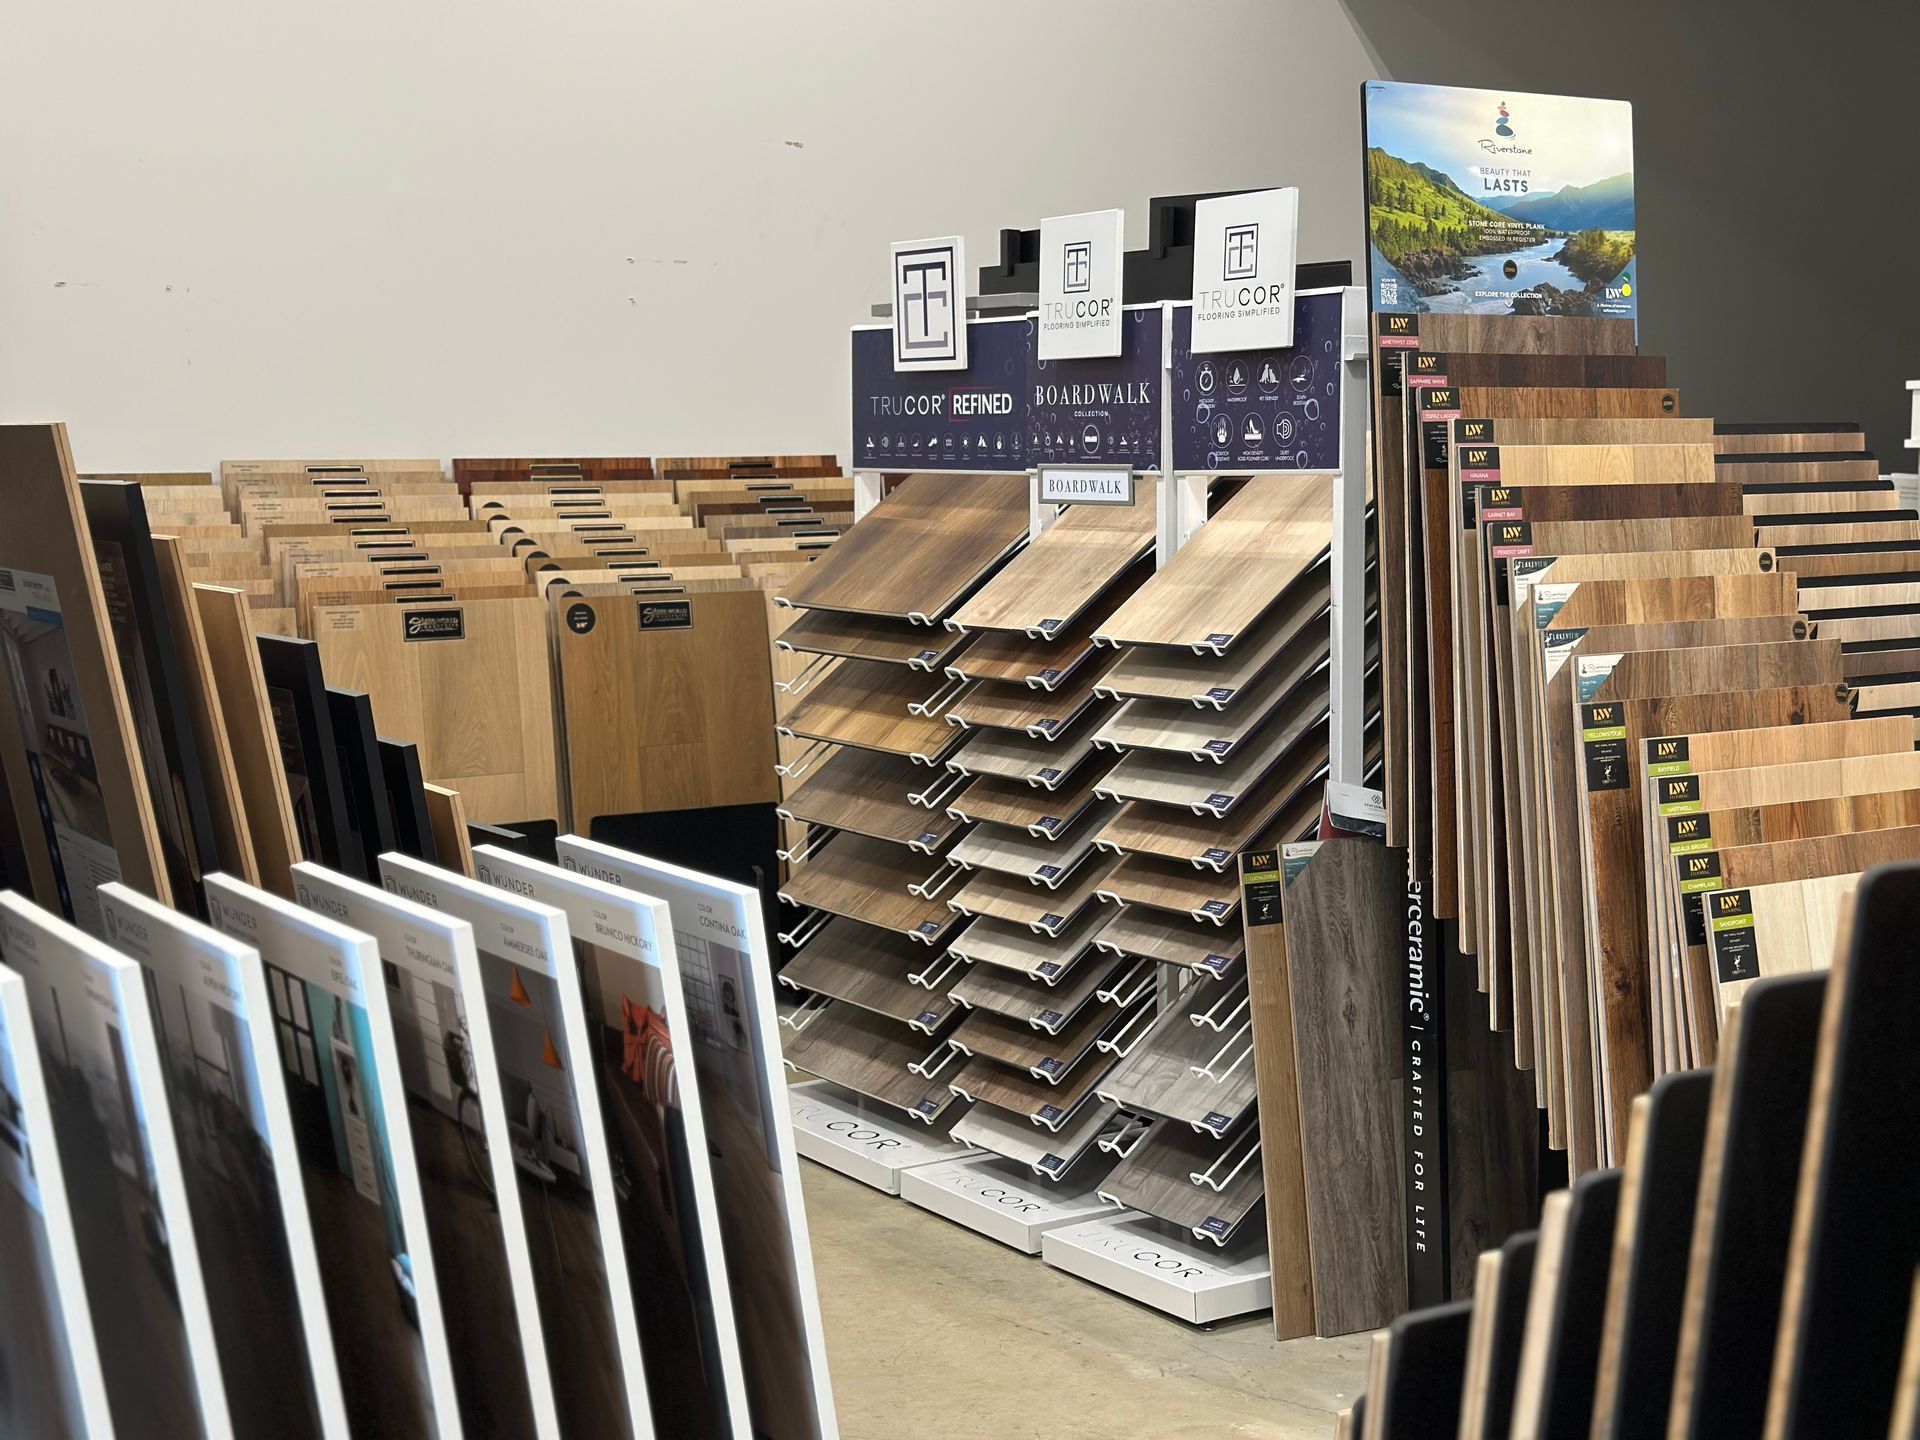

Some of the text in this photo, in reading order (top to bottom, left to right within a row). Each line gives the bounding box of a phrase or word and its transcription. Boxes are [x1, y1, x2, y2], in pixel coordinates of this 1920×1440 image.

[1478, 139, 1532, 154] Riverstone
[1480, 167, 1531, 177] BEAUTY THAT
[1484, 178, 1528, 193] LASTS
[1197, 306, 1280, 321] FLOORING SIMPLIFIED
[1043, 319, 1110, 331] FLOORING SIMPLIFIED
[1035, 383, 1151, 406] BOARDWALK
[953, 393, 1013, 416] REFINED
[1073, 410, 1109, 418] COLLECTION
[1049, 479, 1121, 494] BOARDWALK
[1687, 881, 1716, 890] CHAMPLAIN
[593, 910, 607, 921] COLOR
[697, 903, 713, 914] COLOR
[699, 915, 747, 941] CONTINA OAK
[1720, 918, 1747, 928] SANDPOINT
[1407, 880, 1430, 1254] erceramic® CRAFTED FOR LIFE
